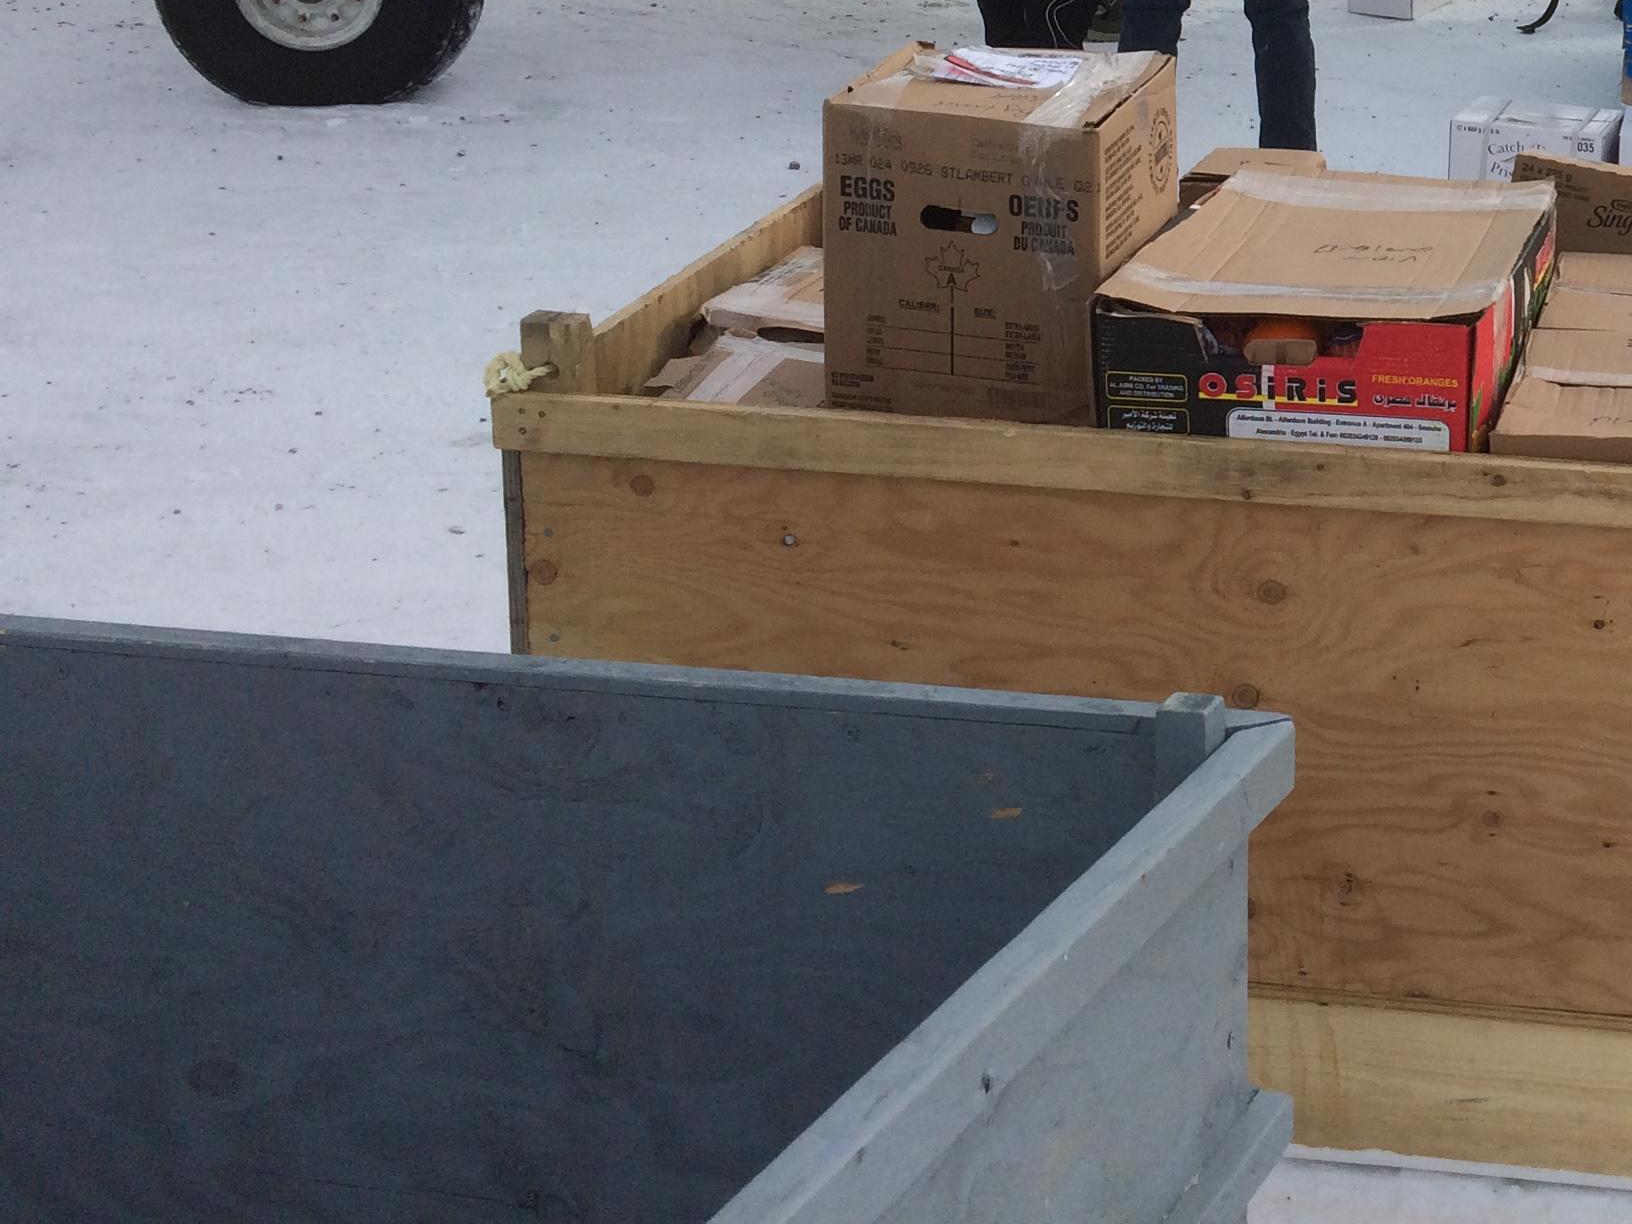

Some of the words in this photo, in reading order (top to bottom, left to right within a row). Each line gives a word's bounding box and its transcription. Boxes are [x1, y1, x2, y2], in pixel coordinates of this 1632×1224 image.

[839, 175, 896, 202] EGGS
[843, 200, 893, 218] PRODUCT
[1008, 194, 1080, 222] OEUFS
[838, 216, 853, 232] OF
[855, 217, 898, 237] CANADA
[1020, 221, 1068, 238] PRODUIT
[1013, 235, 1029, 251] DU
[1031, 237, 1075, 256] CANADA
[945, 272, 958, 287] A
[1407, 376, 1459, 389] ORANGES
